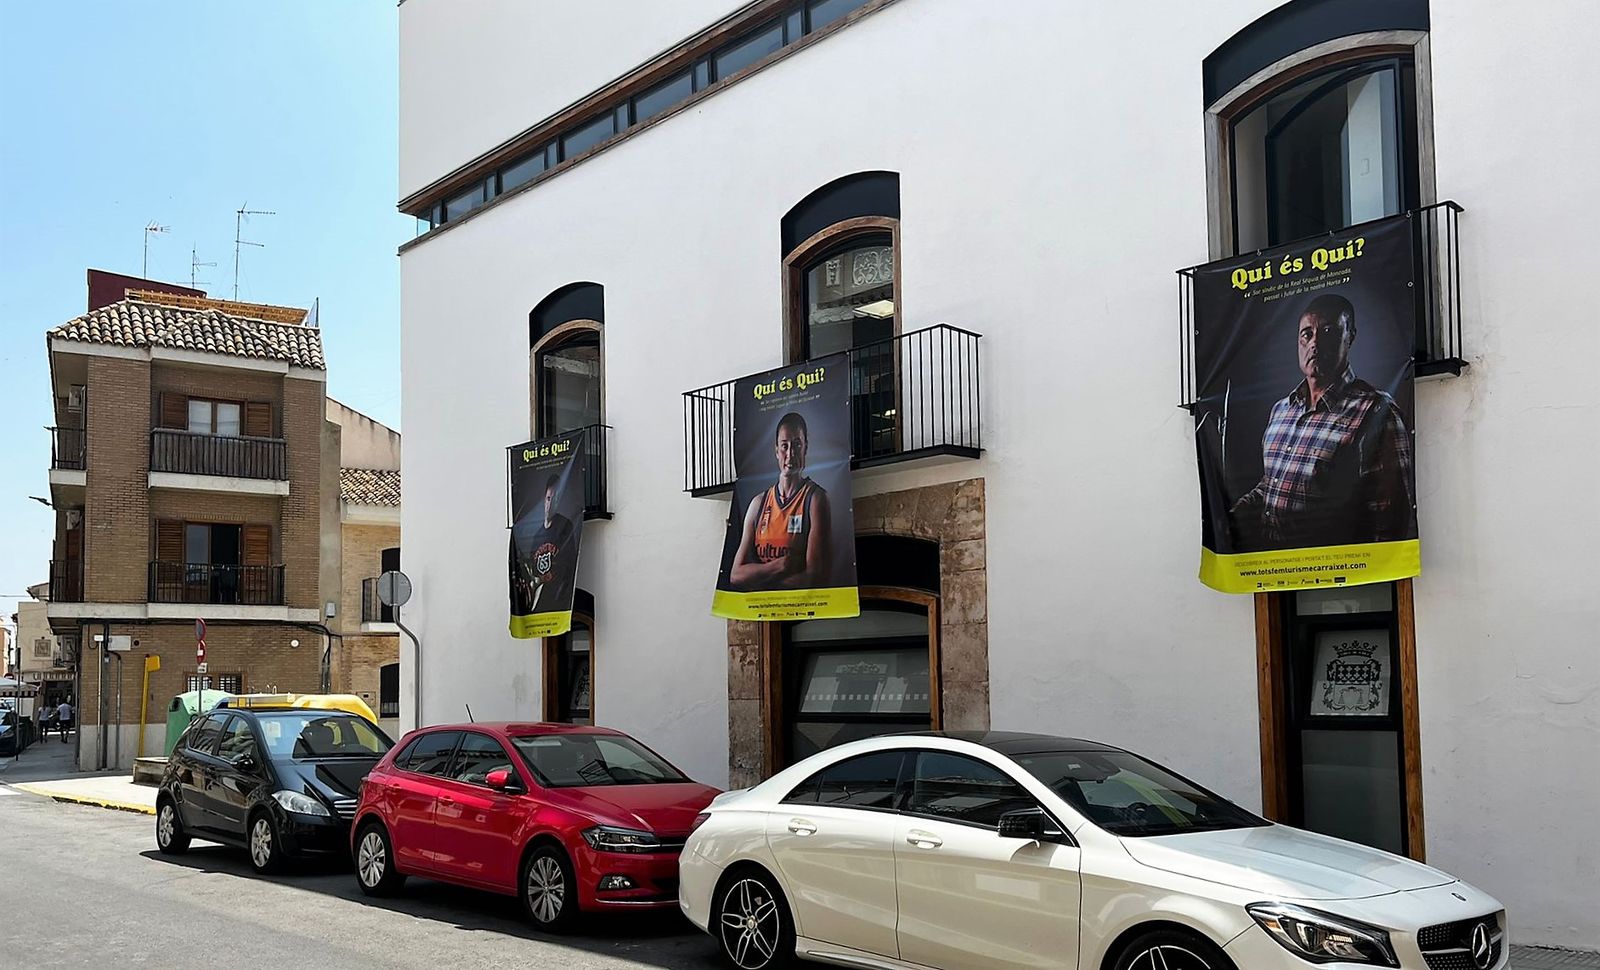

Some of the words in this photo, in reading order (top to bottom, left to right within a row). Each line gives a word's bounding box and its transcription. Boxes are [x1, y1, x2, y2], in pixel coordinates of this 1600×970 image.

[1231, 261, 1272, 290] Qui
[1280, 255, 1303, 275] és
[1311, 238, 1365, 270] Qui?
[753, 380, 776, 400] Qui
[779, 376, 793, 391] és
[796, 367, 825, 390] Qui?
[523, 447, 538, 462] Qui
[540, 444, 549, 456] és
[551, 440, 570, 456] Qui?
[1240, 563, 1367, 576] www.totsfemturismecarraixet.com
